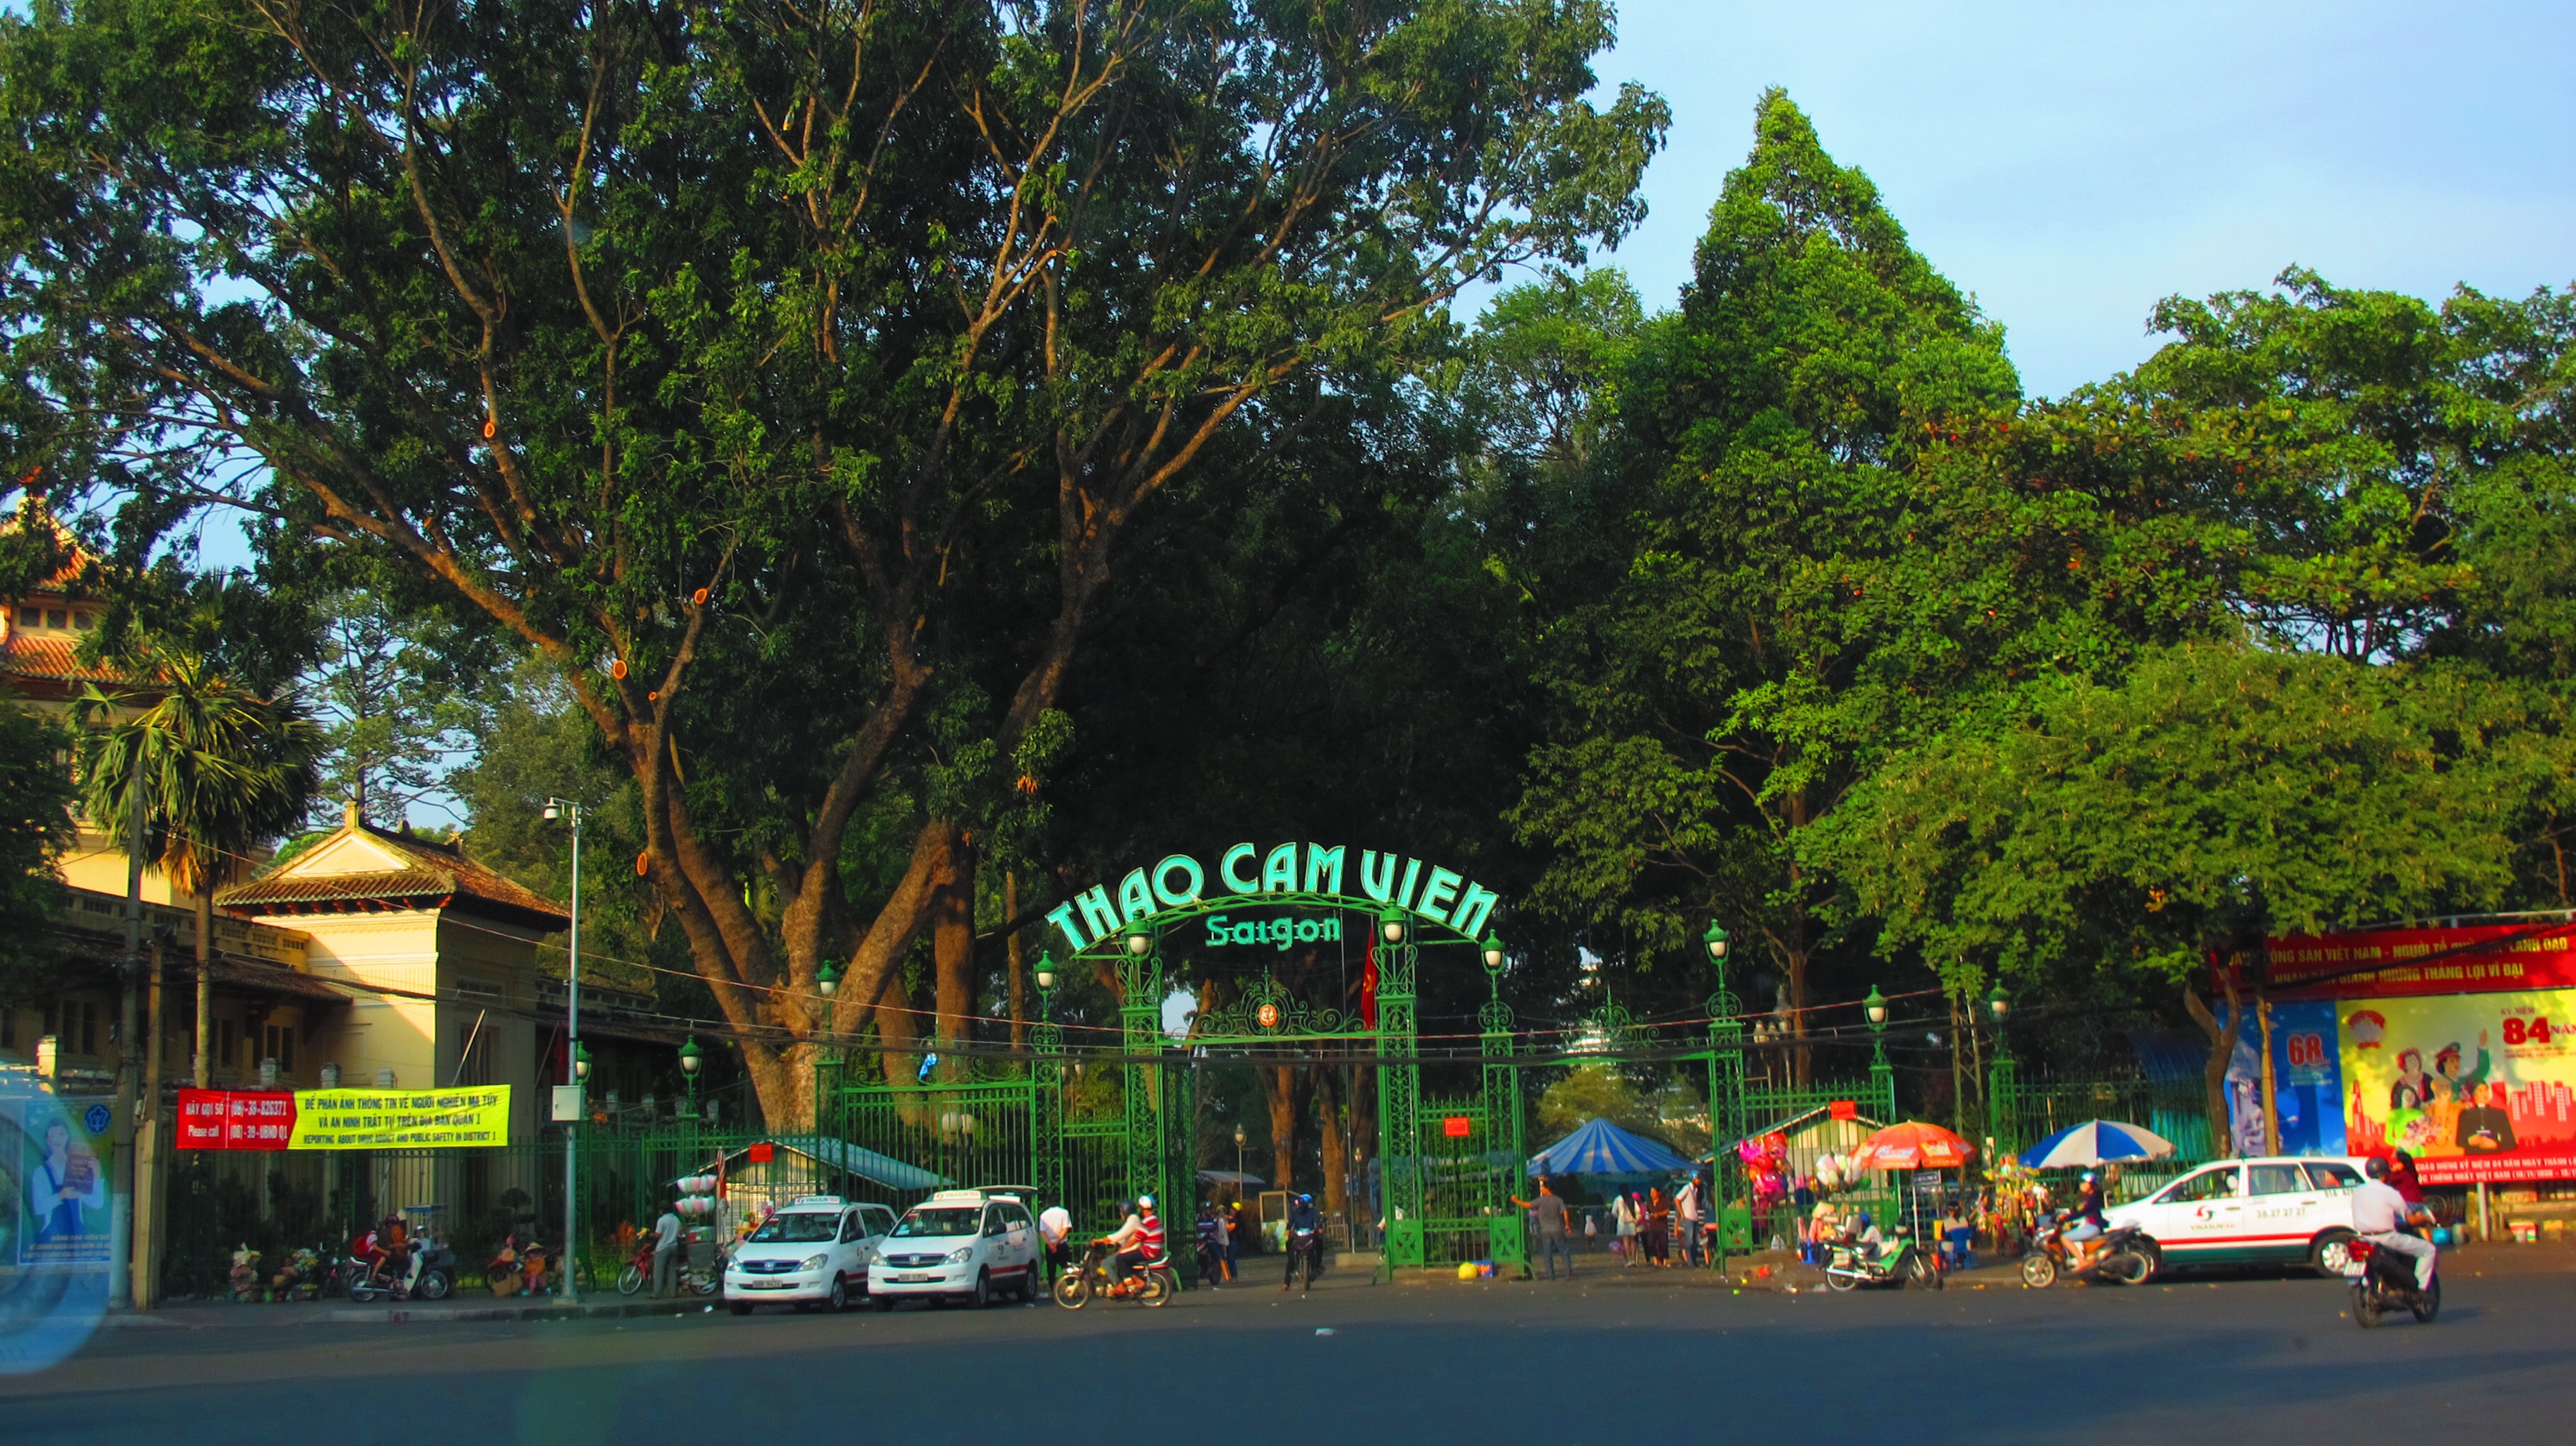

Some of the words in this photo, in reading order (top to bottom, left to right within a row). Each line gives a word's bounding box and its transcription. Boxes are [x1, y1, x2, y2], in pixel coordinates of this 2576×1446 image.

[1044, 854, 1205, 953] THAO
[1220, 842, 1347, 895] CAM
[1361, 849, 1500, 938] VIEN
[1205, 915, 1340, 951] Saigon
[2325, 944, 2350, 961] VIỆT
[2354, 946, 2382, 960] NAM
[2503, 1017, 2551, 1045] 84
[2287, 1034, 2322, 1067] 68
[384, 1098, 397, 1109] TIN
[188, 1125, 207, 1137] Please
[208, 1125, 219, 1137] call
[330, 1117, 340, 1128] AN
[304, 1134, 335, 1144] REPORTING
[338, 1135, 356, 1144] ABOUT
[397, 1133, 408, 1142] AND
[410, 1133, 431, 1142] PUBLIC
[432, 1132, 453, 1142] SAFETY
[455, 1133, 462, 1141] IN
[463, 1131, 491, 1141] DISTRICT
